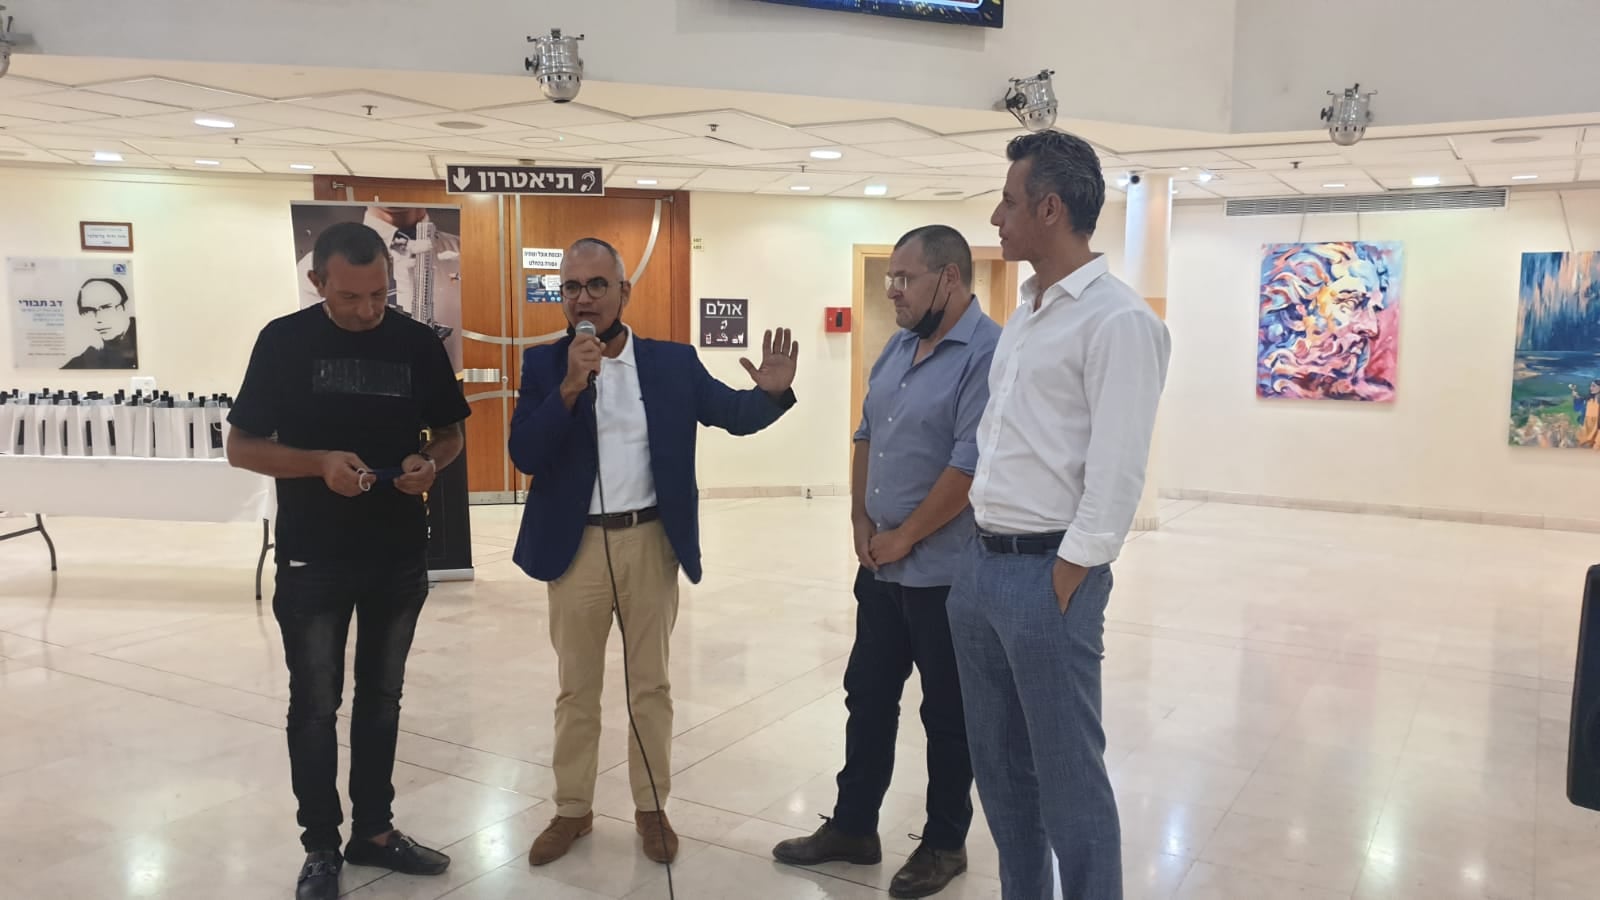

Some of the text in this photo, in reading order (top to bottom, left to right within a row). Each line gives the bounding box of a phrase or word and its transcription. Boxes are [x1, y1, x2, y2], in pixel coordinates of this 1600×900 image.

[478, 171, 574, 191] תיאטרון
[18, 299, 63, 307] דב תבורי
[706, 300, 742, 315] אולם
